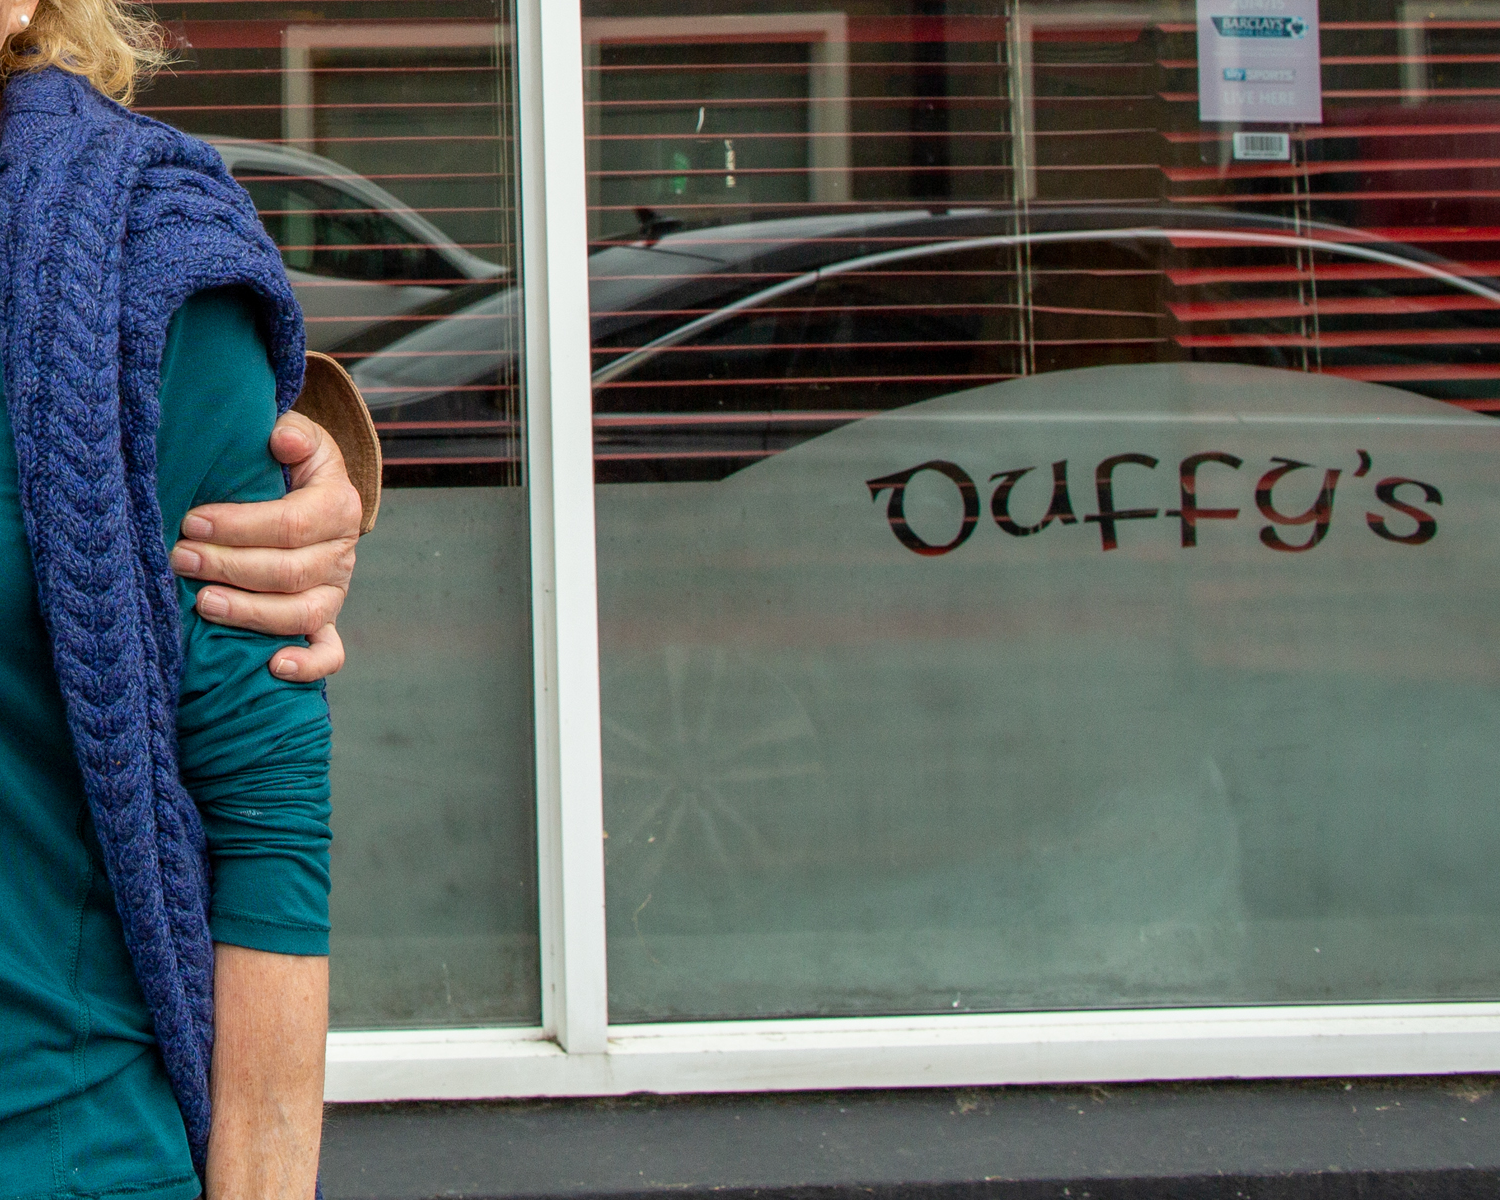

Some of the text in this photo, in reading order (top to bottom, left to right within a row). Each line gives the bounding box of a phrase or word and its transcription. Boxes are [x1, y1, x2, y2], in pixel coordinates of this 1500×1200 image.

[1222, 16, 1285, 31] BARCLAYS
[1223, 90, 1297, 107] LIVE HERE
[866, 449, 1443, 557] Duffy's
